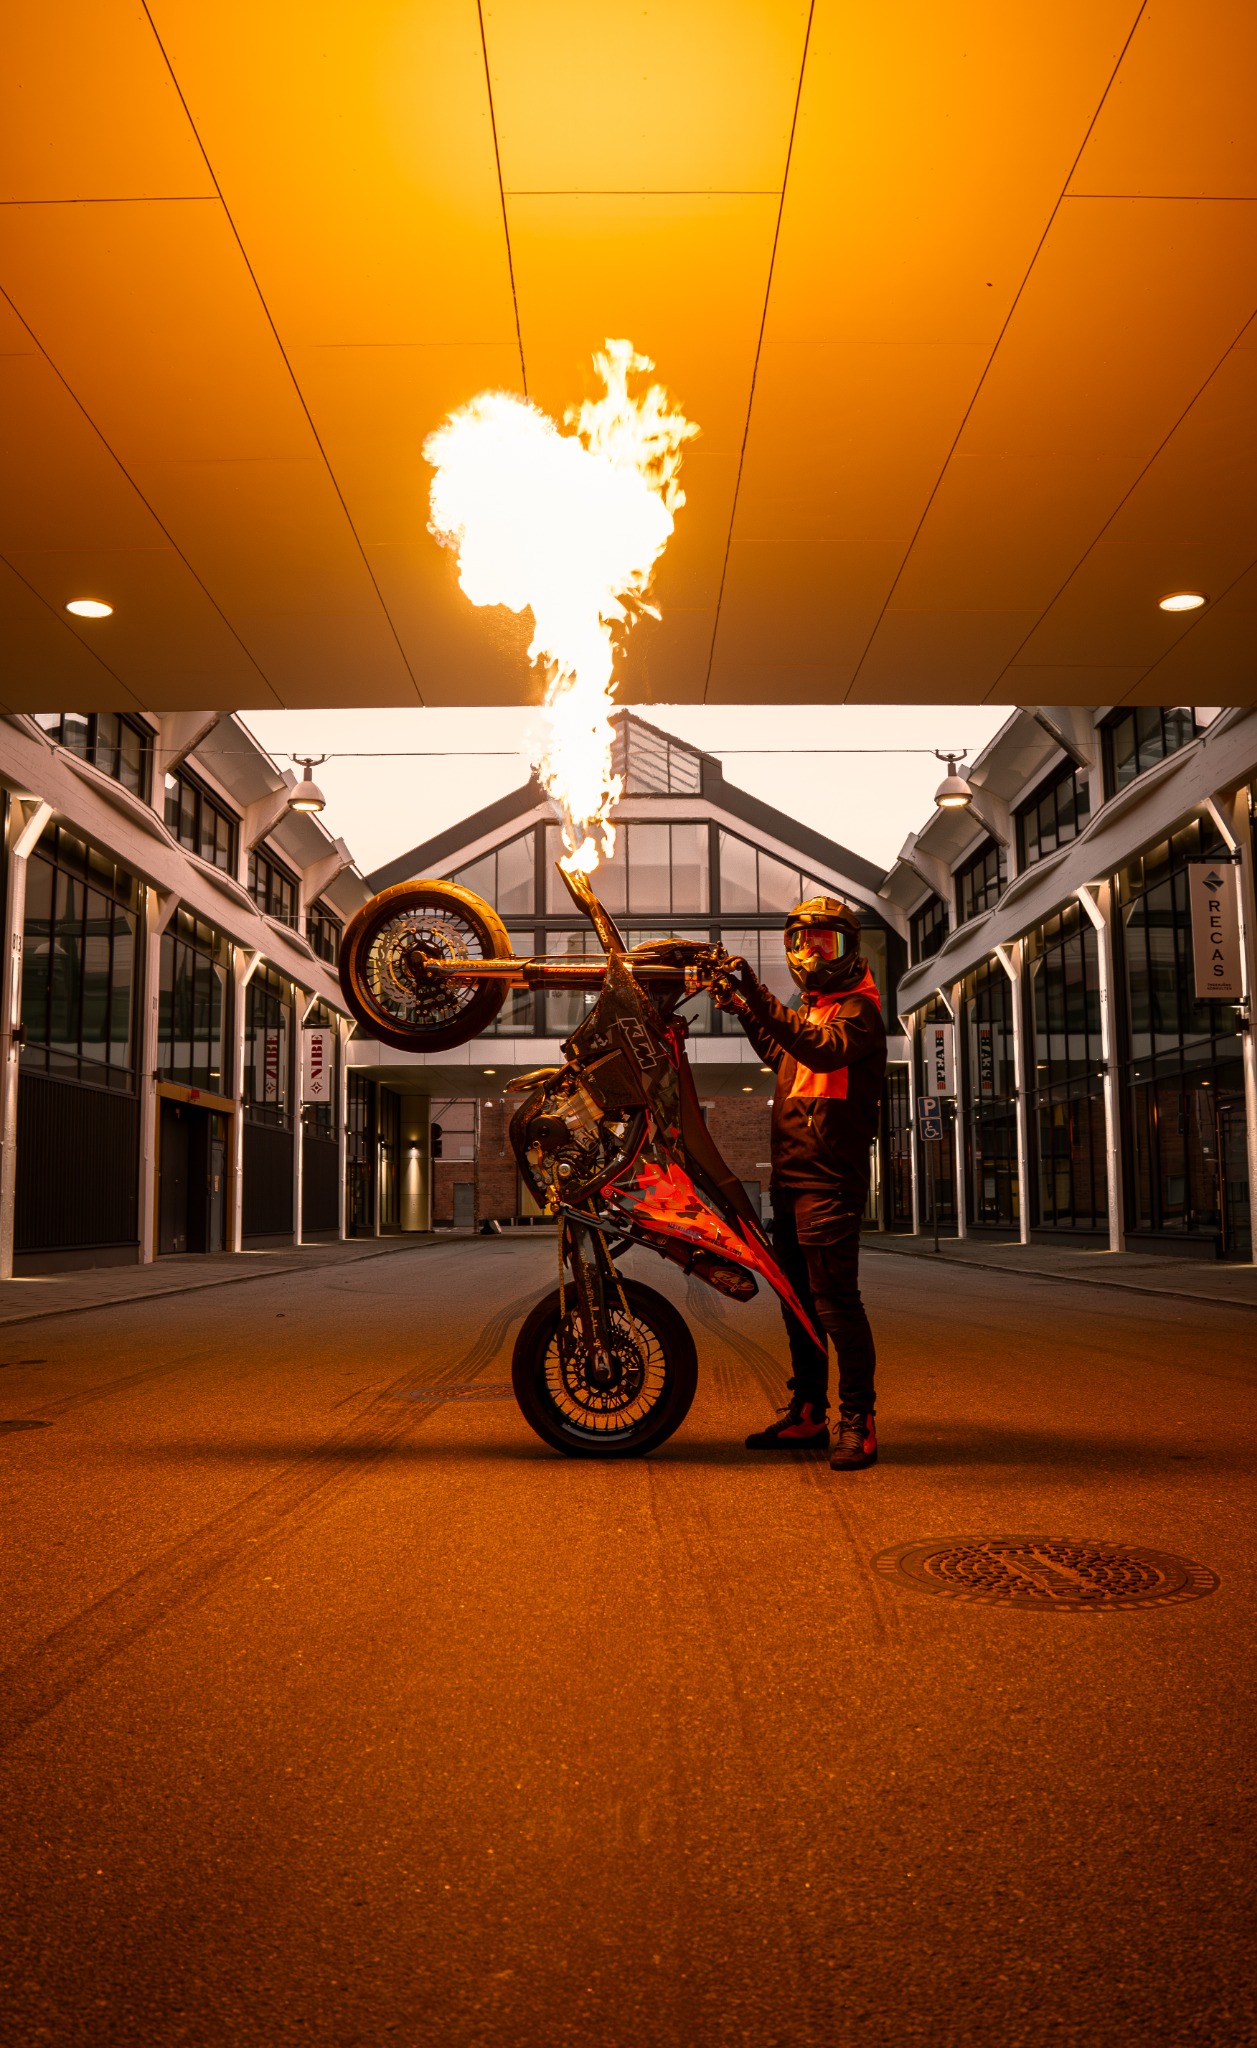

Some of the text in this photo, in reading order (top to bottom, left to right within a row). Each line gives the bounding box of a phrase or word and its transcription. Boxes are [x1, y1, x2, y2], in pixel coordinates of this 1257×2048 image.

[1208, 900, 1224, 977] RECAS
[311, 1035, 322, 1079] NIBE
[619, 1017, 657, 1069] KTM
[935, 1037, 945, 1082] PEAB
[924, 1099, 936, 1116] P
